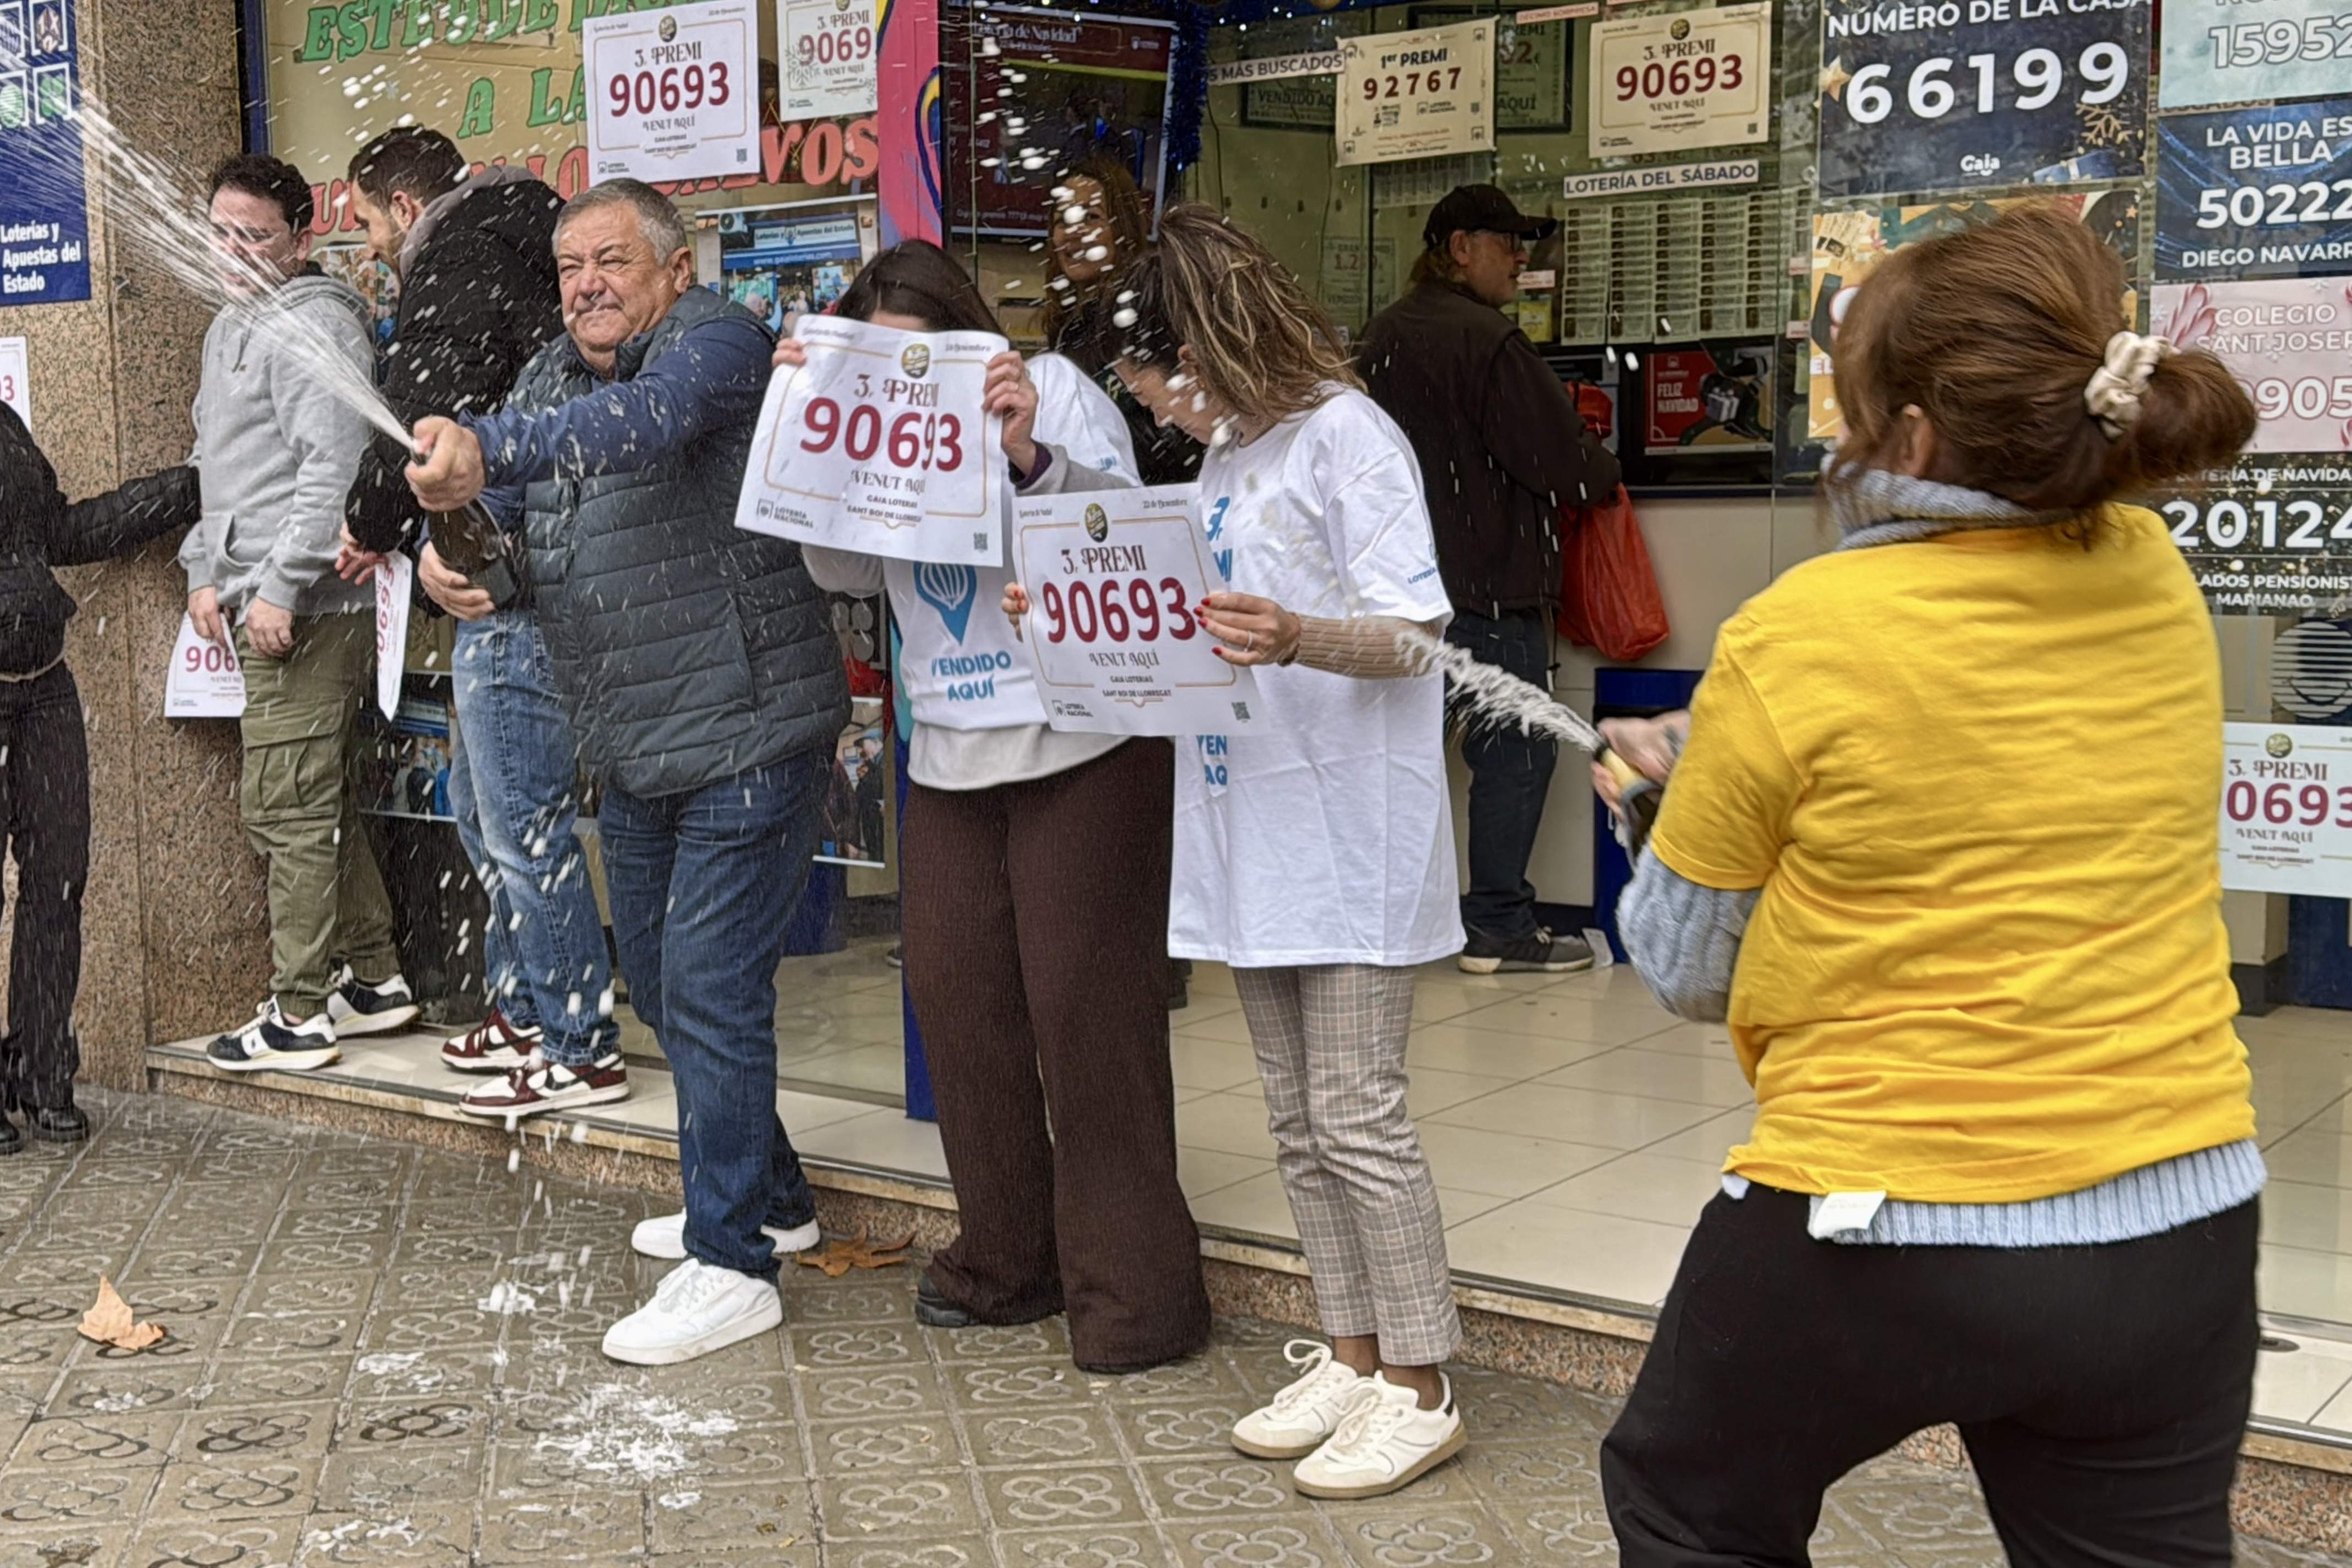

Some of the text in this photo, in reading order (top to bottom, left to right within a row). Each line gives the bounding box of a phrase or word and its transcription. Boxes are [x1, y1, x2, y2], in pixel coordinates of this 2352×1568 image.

[301, 0, 435, 62] ESTE
[830, 10, 869, 28] PREMI
[1827, 6, 1961, 37] NÚMERO
[1969, 0, 2018, 24] DE
[2020, 0, 2060, 18] LA
[651, 41, 702, 64] PREMI
[799, 27, 871, 66] 9069
[1400, 48, 1447, 67] PREMI
[1662, 39, 1716, 58] PREMI
[1221, 64, 1254, 80] MÁS
[1258, 55, 1342, 76] BUSCADOS
[1616, 54, 1743, 101] 90693
[609, 62, 729, 116] 90693
[1364, 67, 1461, 100] 92767
[1847, 42, 2128, 123] 66199
[457, 77, 494, 139] A
[2207, 117, 2352, 146] LA VIDA ES
[2230, 142, 2334, 170] BELLA
[1566, 161, 1756, 194] LOTERÍA DEL SÁBADO
[0, 219, 59, 243] Loterías y
[2, 240, 81, 272] Apuestas del
[2182, 247, 2255, 268] DIEGO
[3, 270, 45, 294] Estado
[2214, 303, 2337, 327] COLEGIO
[2196, 333, 2266, 354] SANT
[1657, 382, 1683, 398] FELIZ
[1657, 398, 1698, 412] NAVIDAD
[801, 397, 963, 472] 90693
[2255, 467, 2278, 482] DE
[1081, 545, 1147, 574] PREMI
[1042, 576, 1196, 643] 90693
[2216, 592, 2313, 608] MARIANAO
[2253, 760, 2328, 781] PREMI
